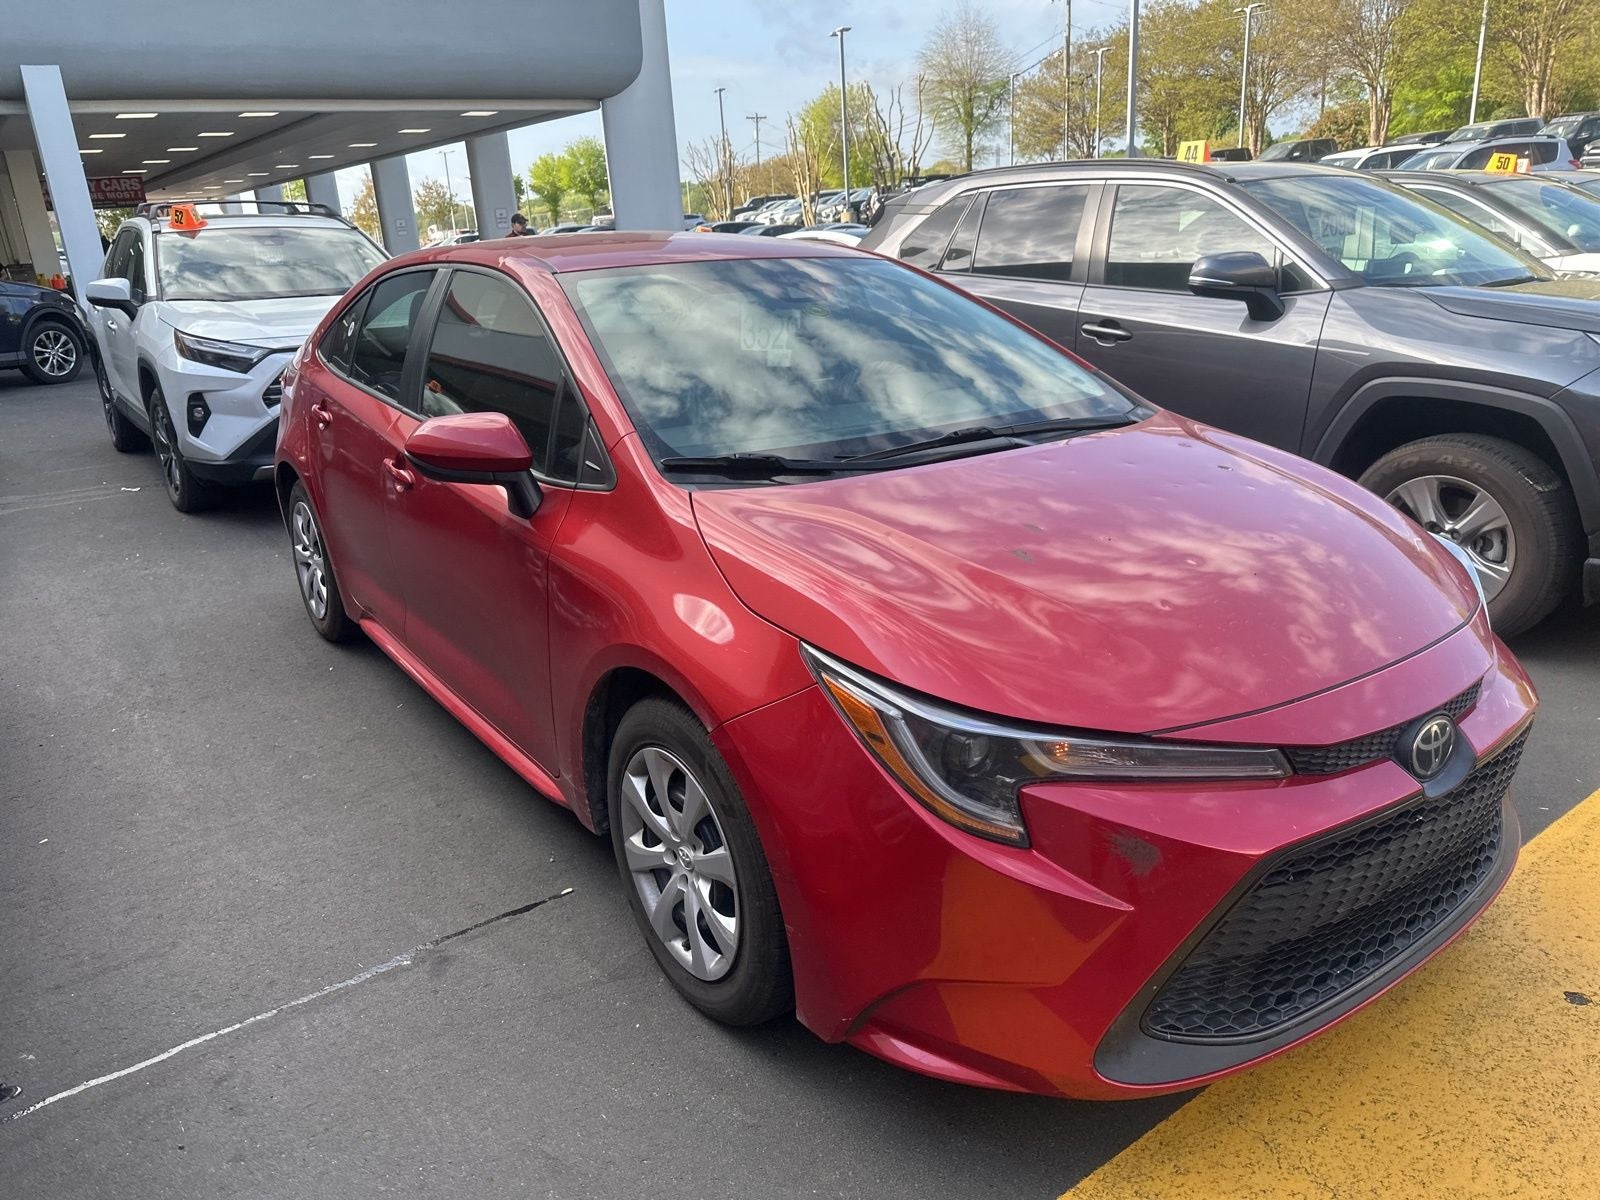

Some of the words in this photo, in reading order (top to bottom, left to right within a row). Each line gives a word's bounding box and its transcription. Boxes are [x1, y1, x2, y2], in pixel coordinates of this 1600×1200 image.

[1185, 145, 1198, 162] 44
[1497, 157, 1510, 170] 50
[100, 178, 141, 192] CARS
[175, 210, 184, 225] 52
